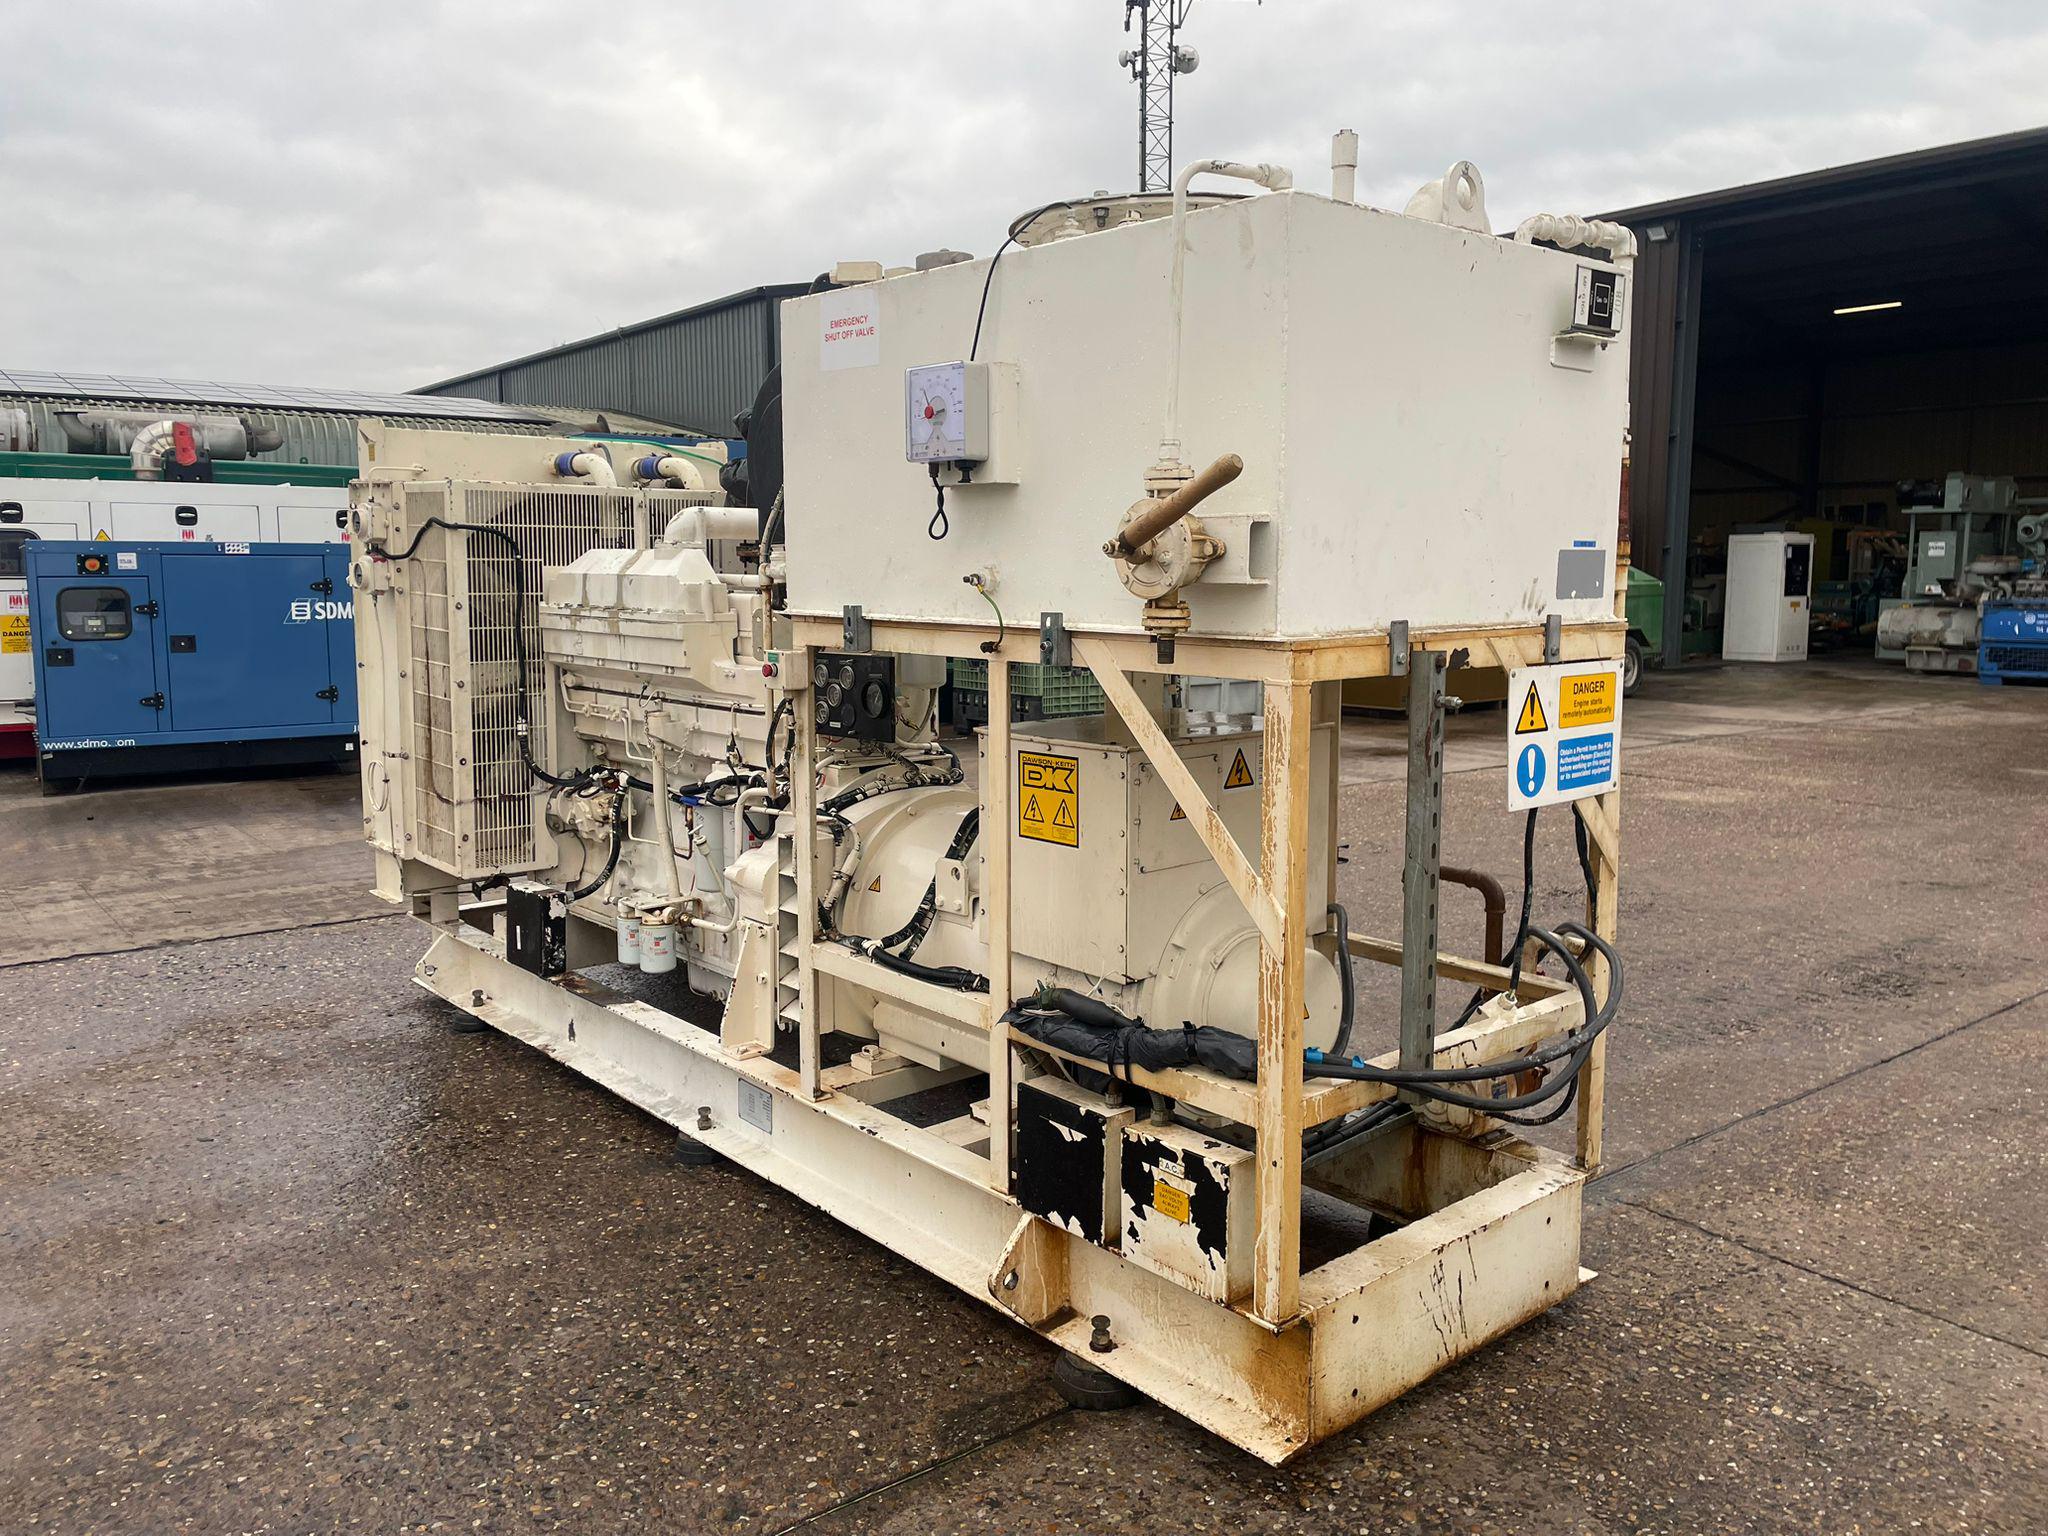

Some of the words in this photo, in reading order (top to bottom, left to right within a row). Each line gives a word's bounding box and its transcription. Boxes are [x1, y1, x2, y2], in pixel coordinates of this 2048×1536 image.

[830, 314, 869, 329] EMERGENCY
[824, 332, 841, 342] SHUT
[842, 330, 854, 340] OFF
[855, 326, 875, 338] VALVE
[314, 602, 355, 620] SDM
[1574, 680, 1605, 695] DANGER
[1574, 699, 1590, 708] Engine
[43, 738, 135, 750] www.sdmo.om
[1022, 762, 1074, 794] DK
